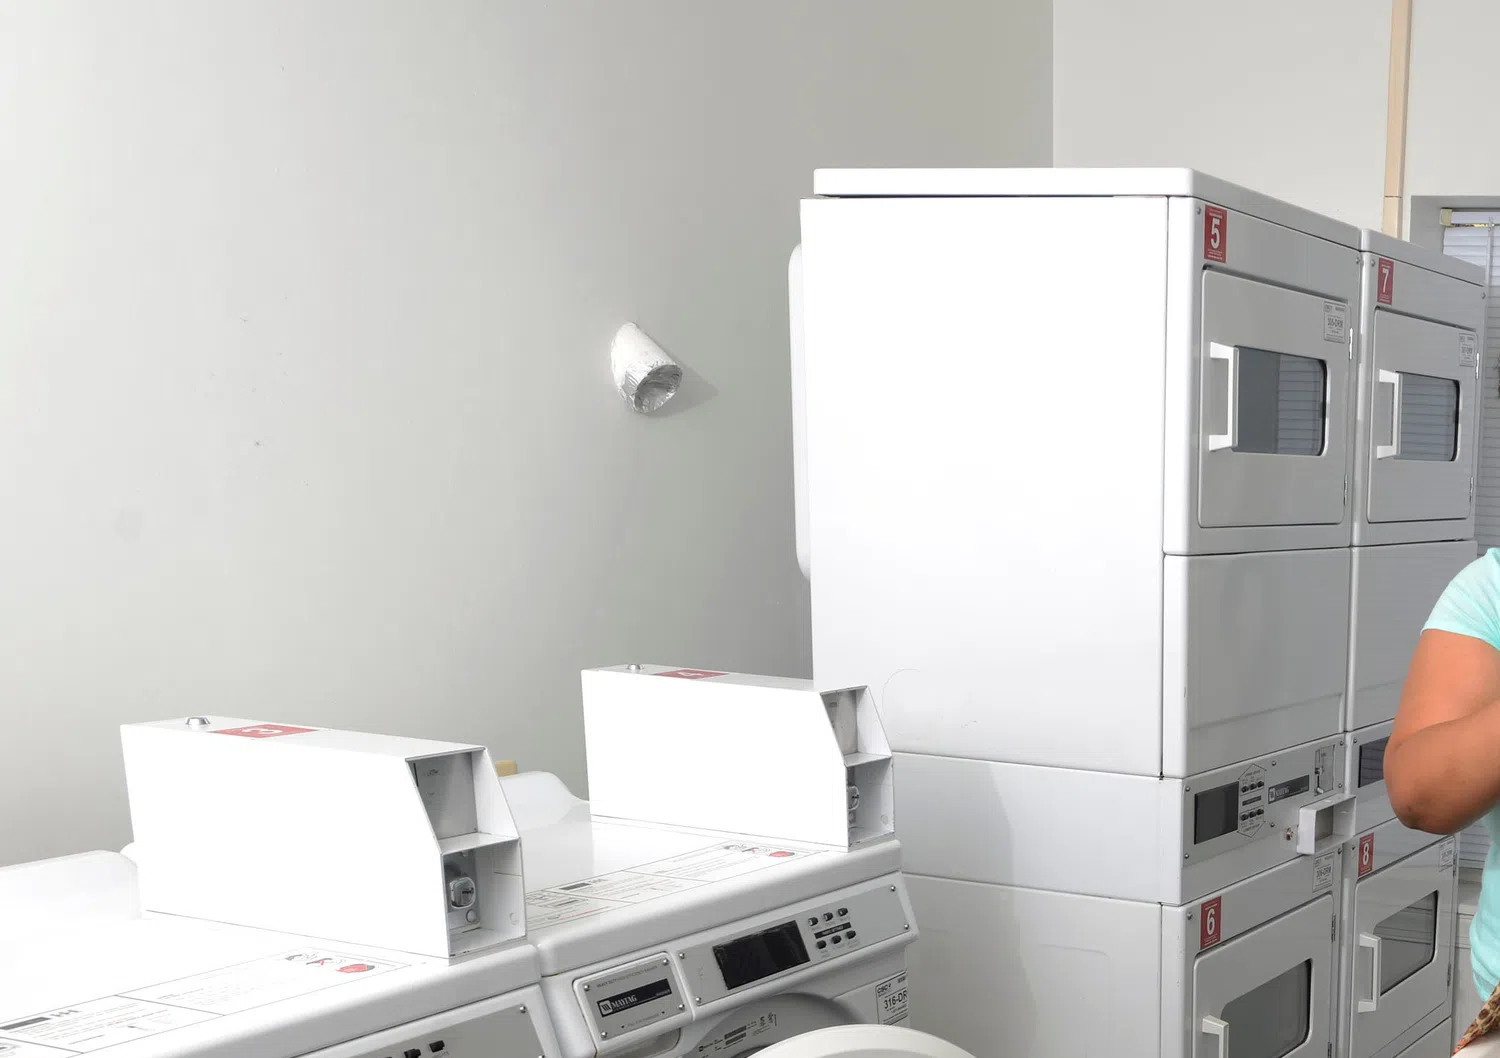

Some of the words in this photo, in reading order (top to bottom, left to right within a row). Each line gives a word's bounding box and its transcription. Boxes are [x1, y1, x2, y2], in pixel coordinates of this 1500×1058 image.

[1210, 217, 1220, 249] 5
[1382, 267, 1390, 293] 7
[1362, 842, 1370, 866] 8
[1206, 908, 1216, 936] 6
[611, 995, 637, 1009] MAYTAG
